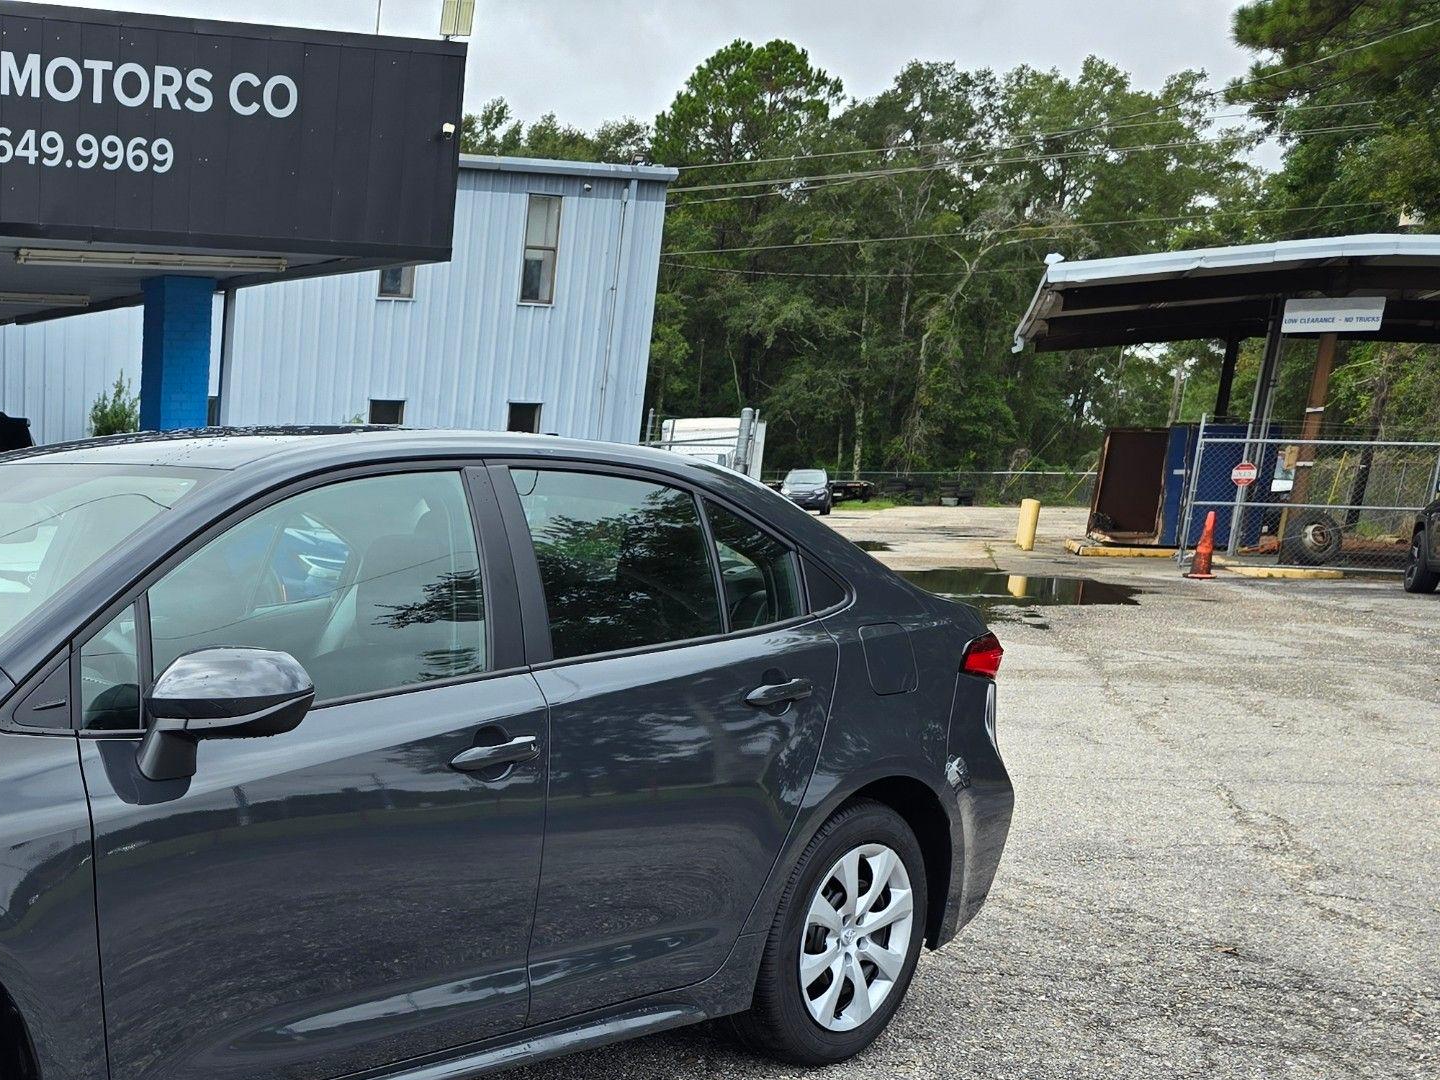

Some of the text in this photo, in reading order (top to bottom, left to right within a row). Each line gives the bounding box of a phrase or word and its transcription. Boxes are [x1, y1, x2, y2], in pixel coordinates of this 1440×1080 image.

[1, 51, 213, 112] MOTORS
[229, 73, 297, 118] CO
[1299, 316, 1336, 324] CLEARANCE
